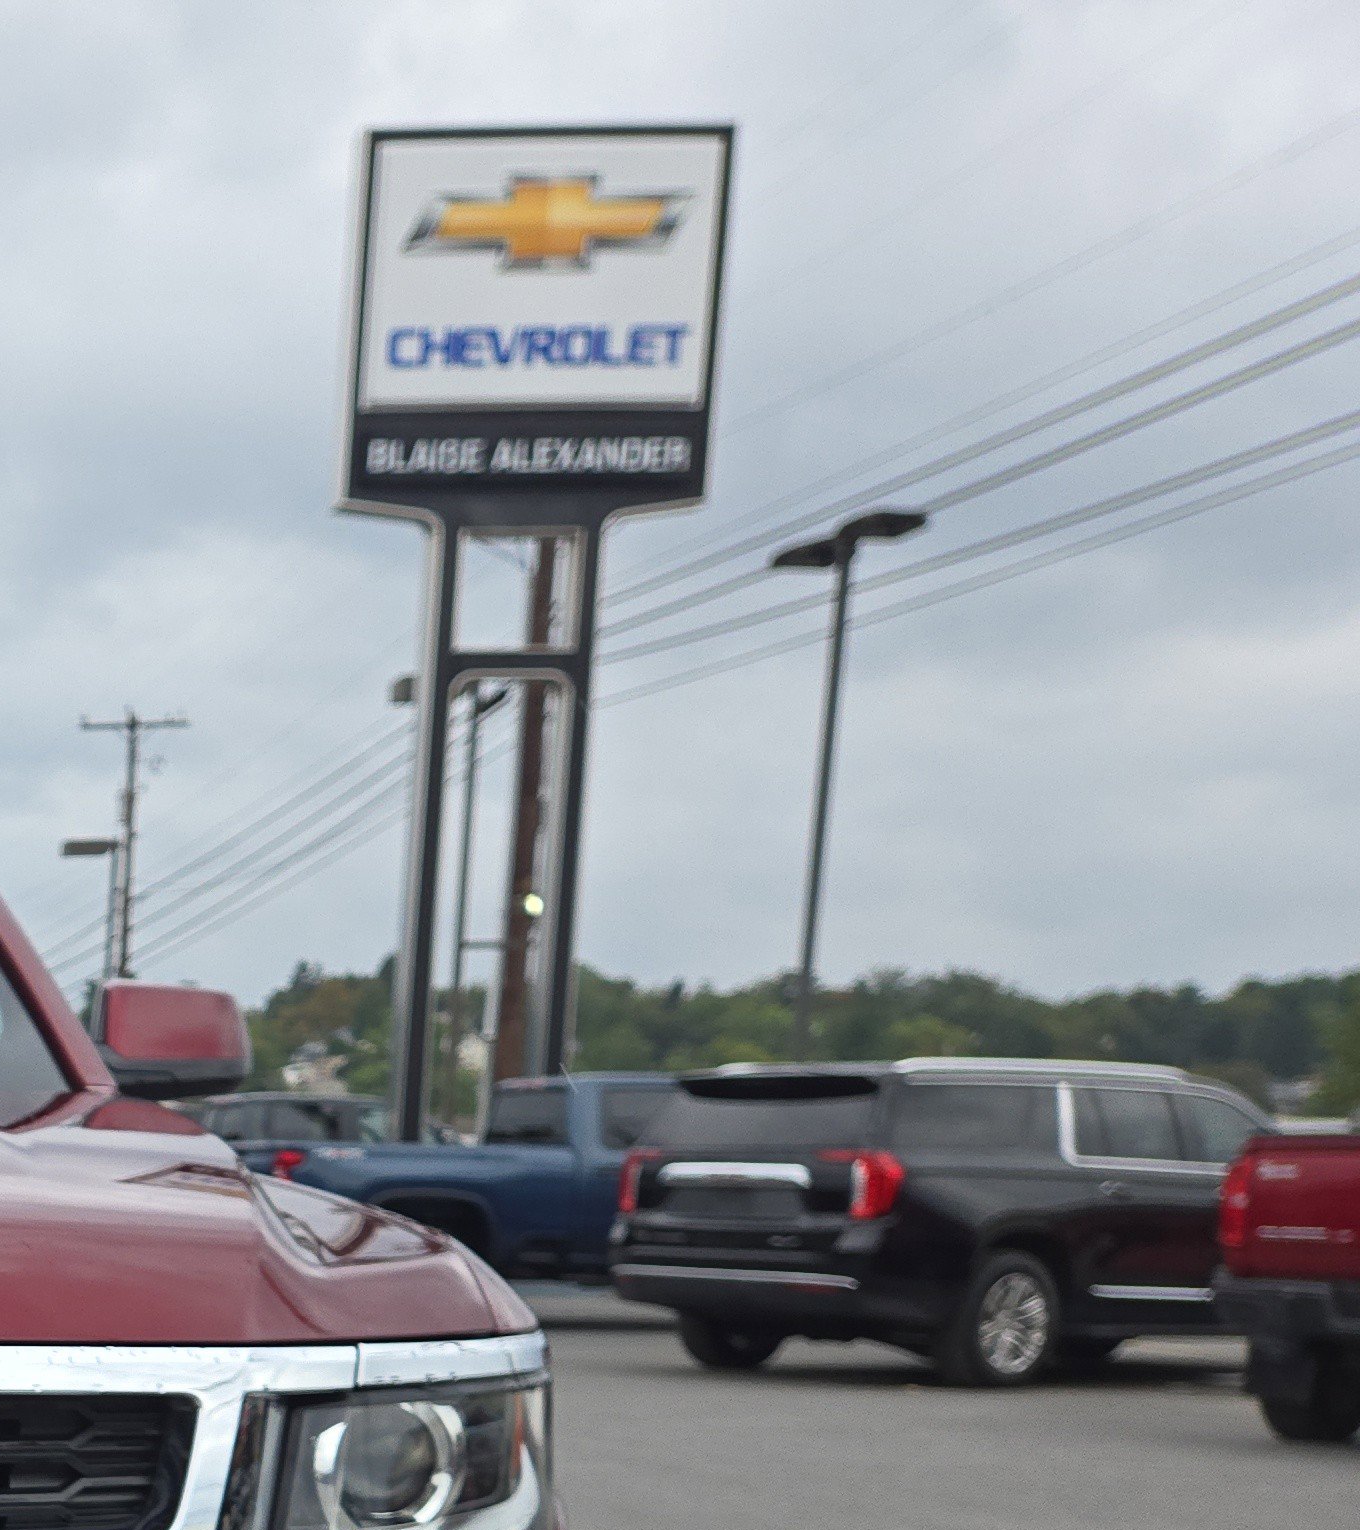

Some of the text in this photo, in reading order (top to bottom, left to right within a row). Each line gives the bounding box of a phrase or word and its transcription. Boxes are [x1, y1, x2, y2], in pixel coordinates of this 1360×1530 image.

[387, 324, 687, 368] CHEVROLET
[366, 436, 691, 474] BLAISE ALEXANDER
